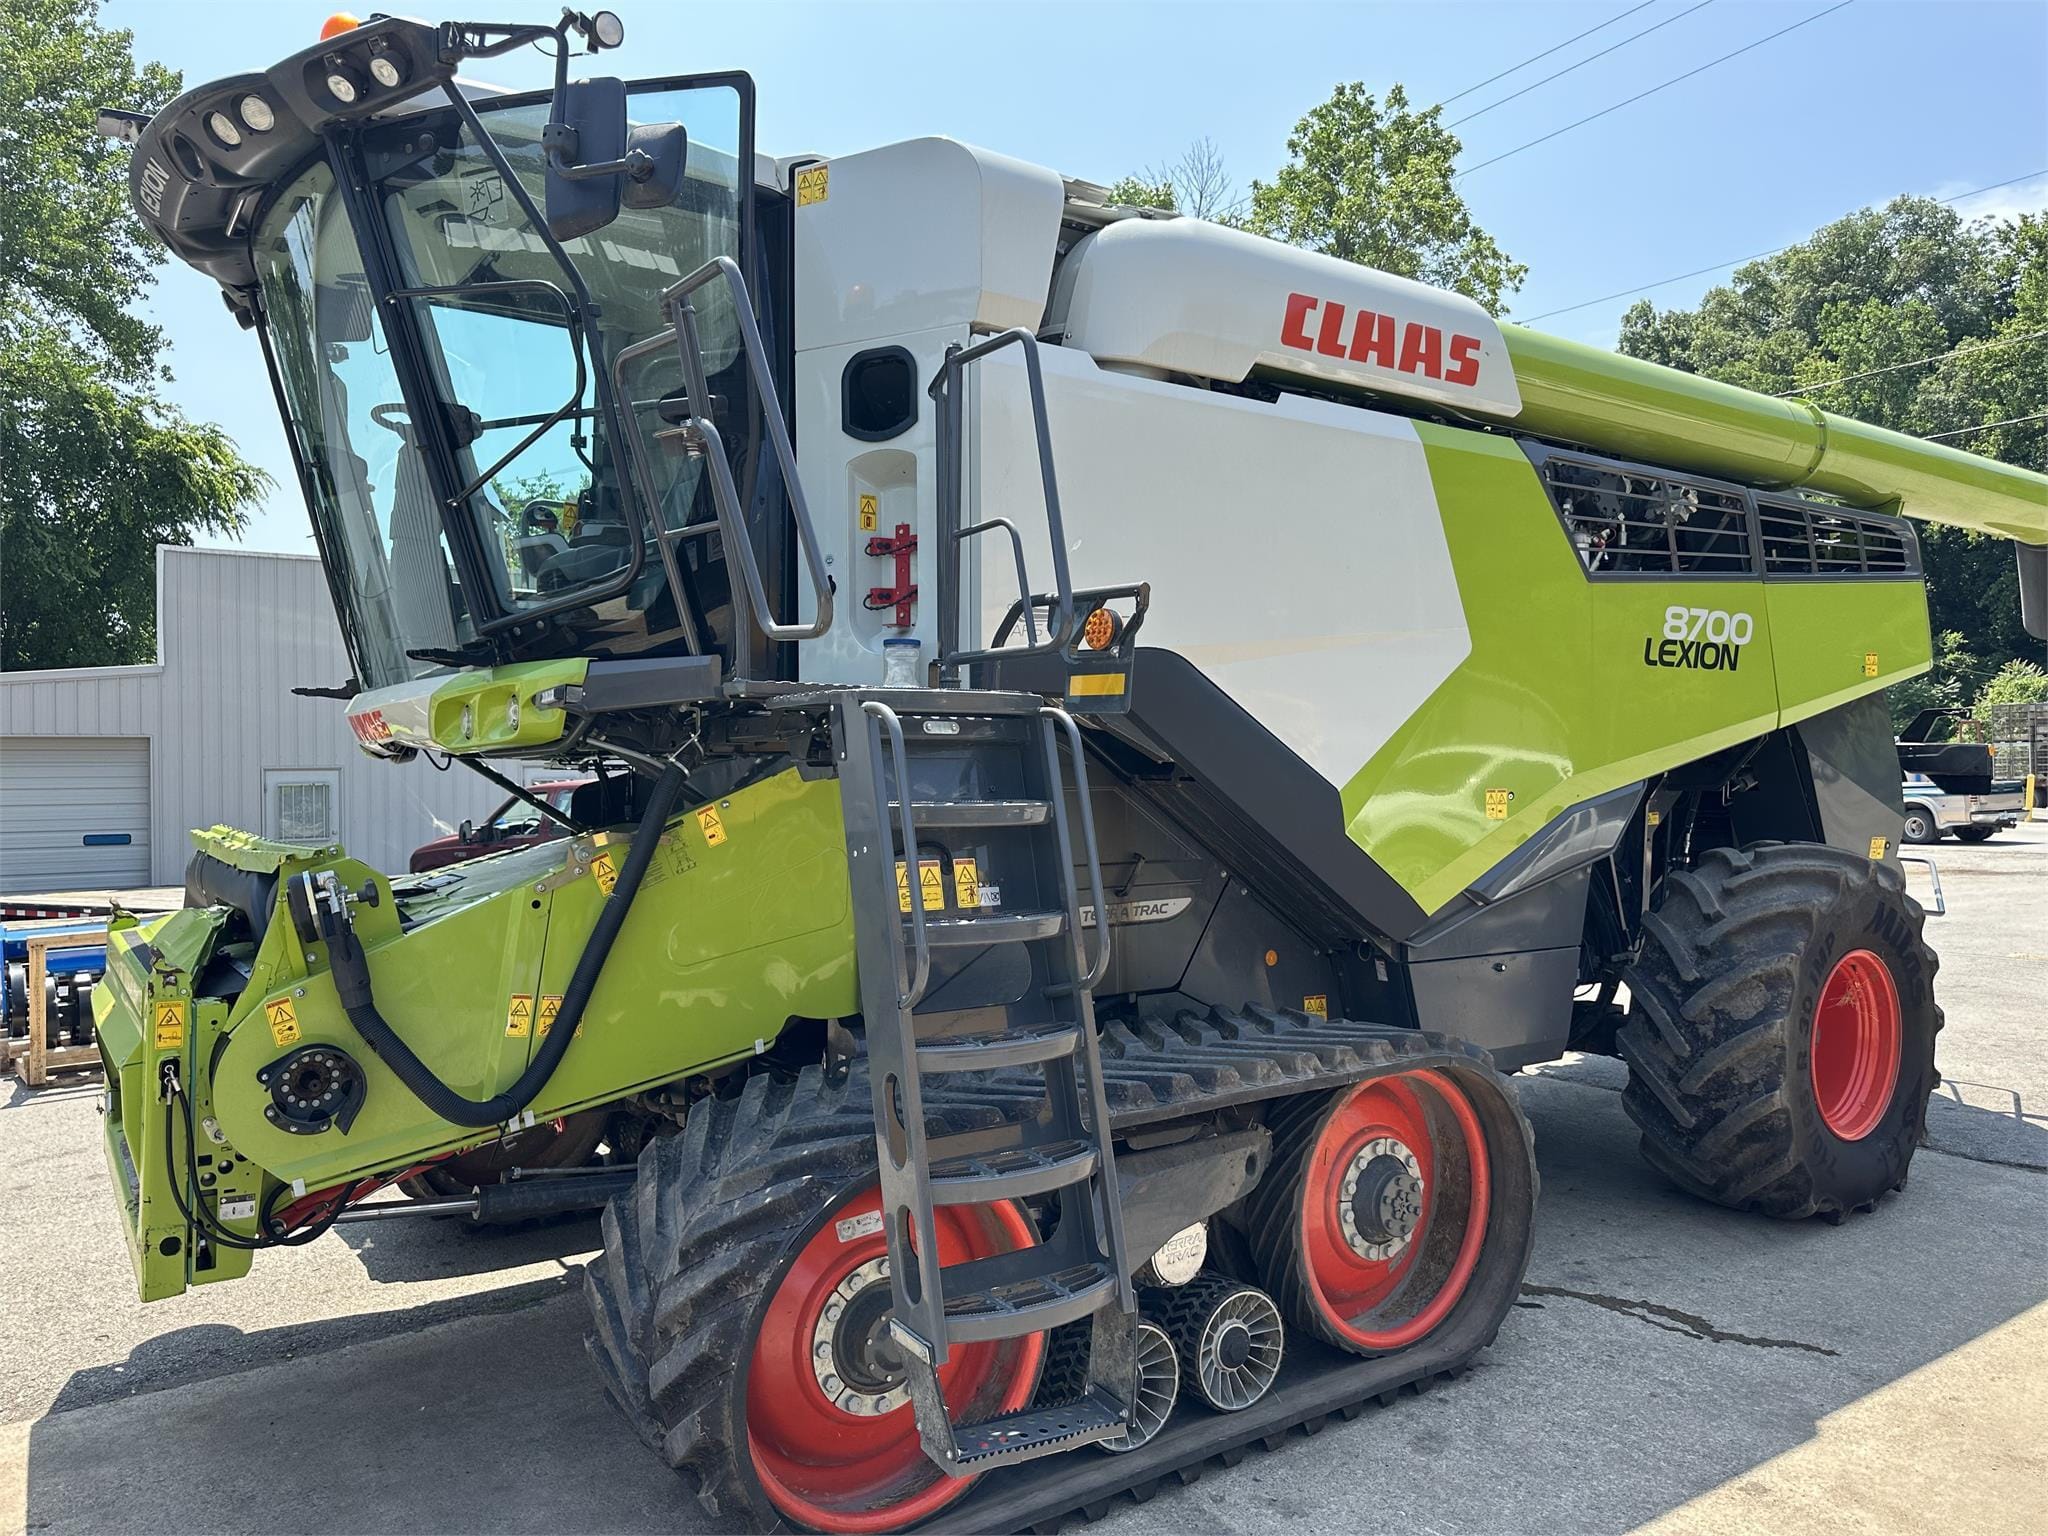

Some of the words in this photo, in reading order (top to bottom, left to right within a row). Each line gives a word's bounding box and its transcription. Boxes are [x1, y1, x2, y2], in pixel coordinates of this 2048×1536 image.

[140, 156, 170, 218] LEXION
[1280, 292, 1482, 387] CLAAS
[1663, 605, 1753, 645] 8700
[1644, 637, 1740, 671] LEXION
[1133, 903, 1169, 917] TRAC
